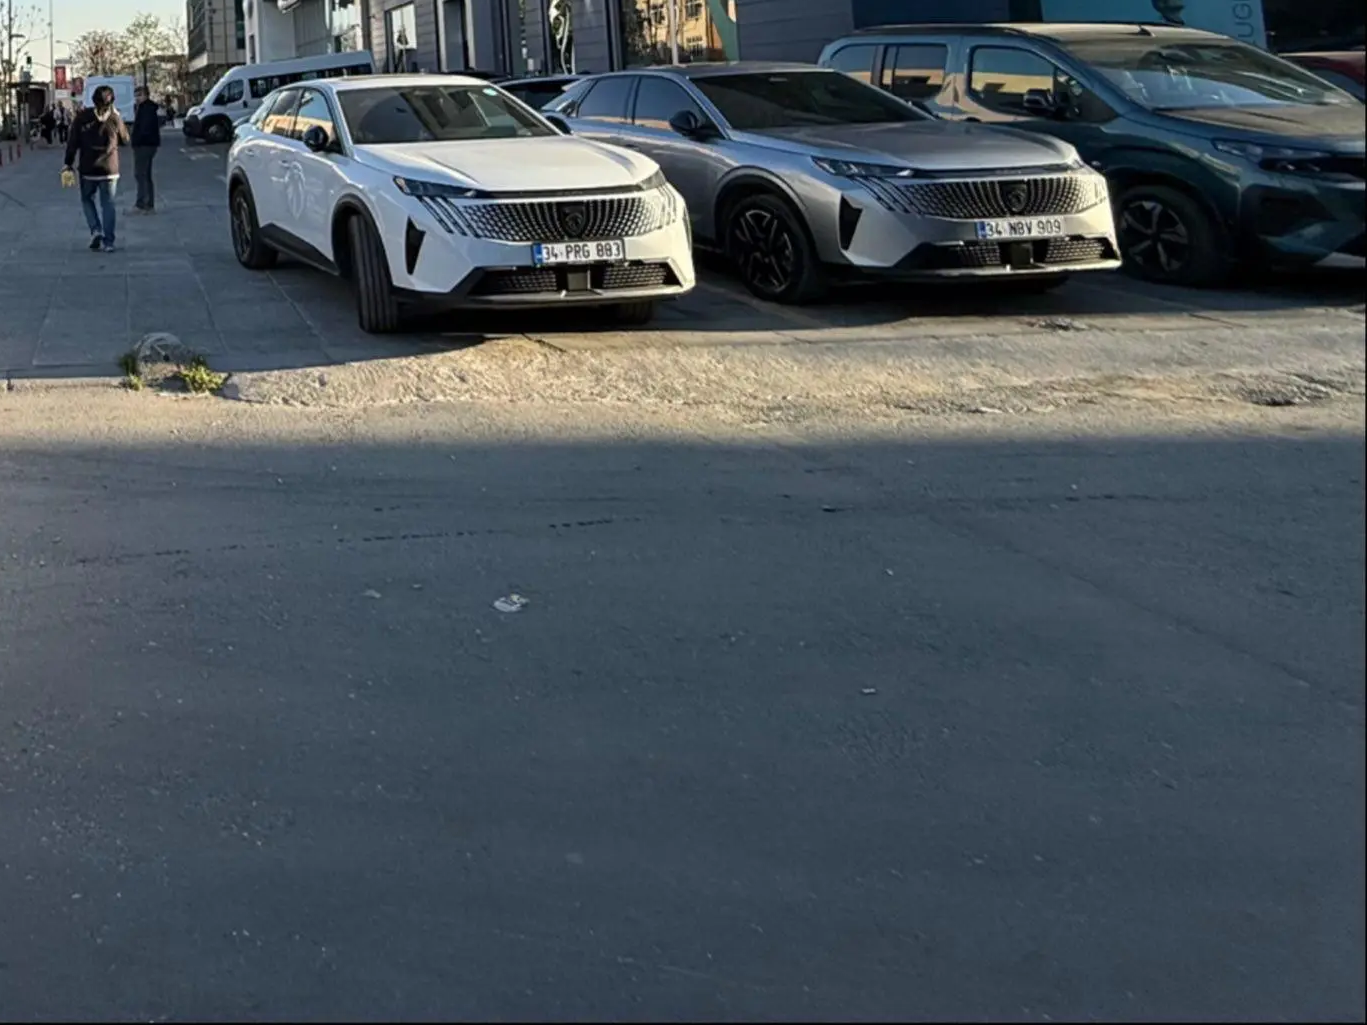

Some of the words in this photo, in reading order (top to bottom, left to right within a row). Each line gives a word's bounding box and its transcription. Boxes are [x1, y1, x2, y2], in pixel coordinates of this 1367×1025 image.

[986, 222, 1002, 236] 34
[1037, 219, 1061, 235] 909
[542, 245, 558, 261] 34
[565, 243, 590, 260] PRG
